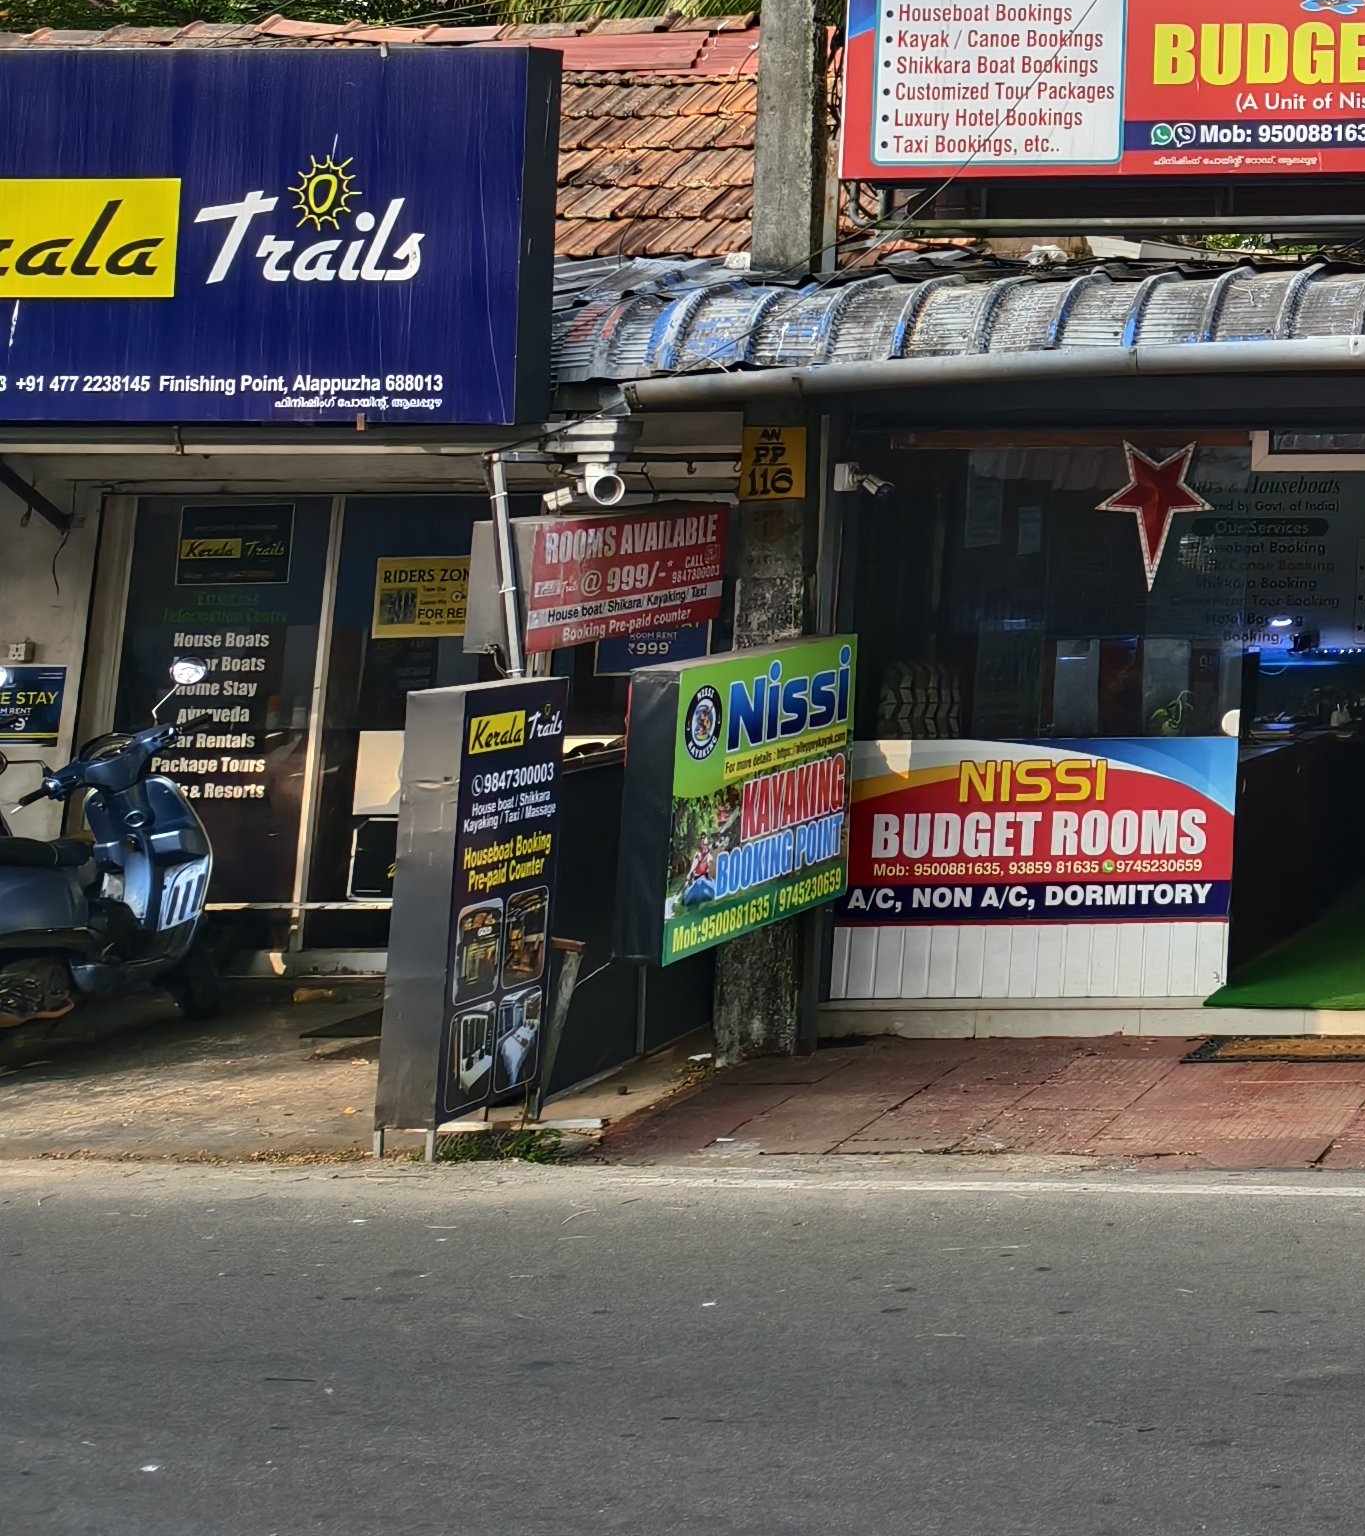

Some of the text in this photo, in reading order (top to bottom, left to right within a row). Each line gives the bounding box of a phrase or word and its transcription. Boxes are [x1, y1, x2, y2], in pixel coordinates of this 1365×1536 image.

[899, 4, 1073, 25] Houseboat Bookings
[898, 30, 1104, 51] Kayak Canoe Bookings
[896, 56, 1098, 77] Shikkara Boat Bookings
[895, 82, 1115, 103] Customized Tour Packages
[1265, 92, 1306, 110] Unit
[895, 108, 1083, 130] Luxury Hotel Bookings
[893, 135, 929, 153] Taxi
[194, 190, 425, 285] Trails
[16, 376, 44, 392] +91
[49, 376, 80, 392] 477
[83, 375, 151, 392] 2238145
[159, 375, 237, 396] Finishing
[292, 374, 382, 396] Alappuzha
[385, 375, 444, 393] 688013
[748, 467, 793, 496] 116
[1250, 519, 1311, 535] Services
[545, 525, 617, 564] ROOMS
[620, 513, 718, 555] AVAILABLE
[1269, 541, 1326, 556] Booking
[685, 553, 705, 570] CALL
[383, 568, 436, 584] RIDERS
[1260, 576, 1317, 590] Booking
[417, 608, 444, 619] FOR
[547, 607, 579, 623] House
[174, 632, 270, 648] House Boats
[562, 621, 606, 644] Booking
[222, 656, 266, 672] Boats
[15, 691, 60, 705] STAY
[223, 680, 257, 698] Stay
[696, 687, 715, 702] NISSI
[726, 644, 851, 753] Nissi
[196, 733, 256, 749] Rentals
[471, 715, 524, 752] Kerala
[221, 757, 266, 773] Tours
[484, 762, 555, 794] 9847300003
[958, 757, 1108, 804] NISSI
[204, 783, 265, 799] Resorts
[741, 752, 846, 842] KAYAKING
[472, 801, 497, 817] House
[504, 808, 521, 823] Taxi
[871, 809, 1207, 859] BUDGET ROOMS
[463, 837, 515, 870] Houseboat
[715, 811, 844, 901] BOOKING POINT
[508, 857, 546, 882] Counter
[873, 859, 1203, 877] Mob: 93859 81635 9745230659
[779, 867, 842, 914] 9745230659
[911, 883, 1213, 908] NON DORMITORY
